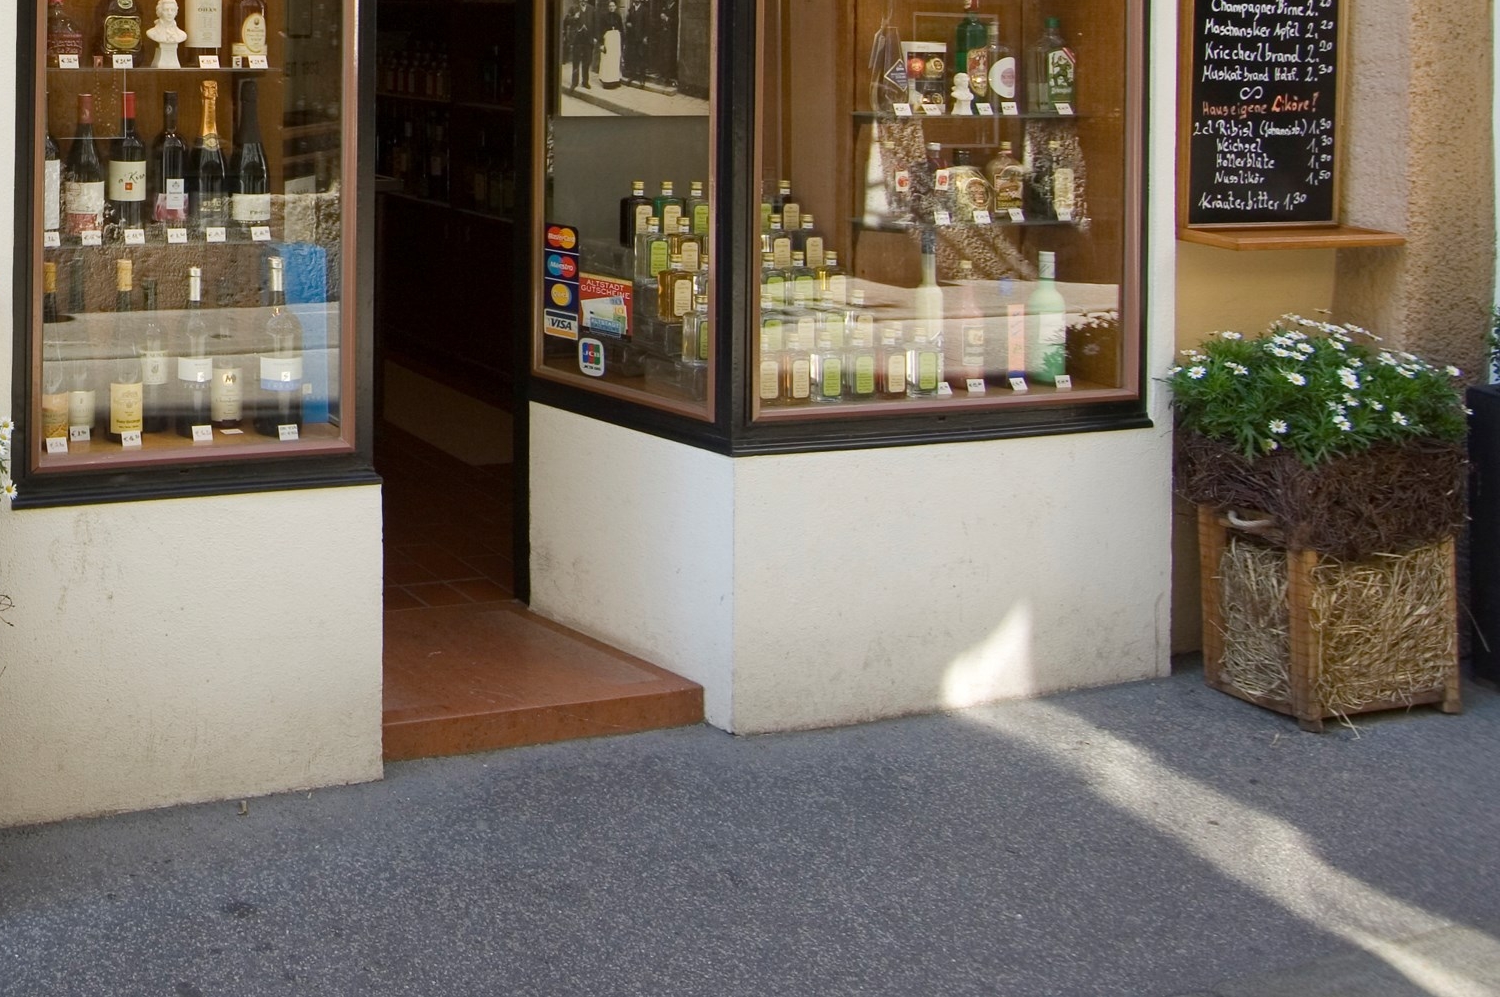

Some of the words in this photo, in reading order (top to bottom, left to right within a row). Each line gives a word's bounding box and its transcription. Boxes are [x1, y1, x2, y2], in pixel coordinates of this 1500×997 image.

[1273, 21, 1300, 41] Apfel
[1215, 120, 1253, 138] Ribisl
[1217, 138, 1262, 153] Weichsel
[1198, 191, 1279, 211] Kräuterbitter
[550, 261, 574, 272] Maestro
[580, 285, 631, 300] GUTSCHEINE
[586, 279, 624, 291] ALTSTADT
[551, 318, 573, 330] VISA
